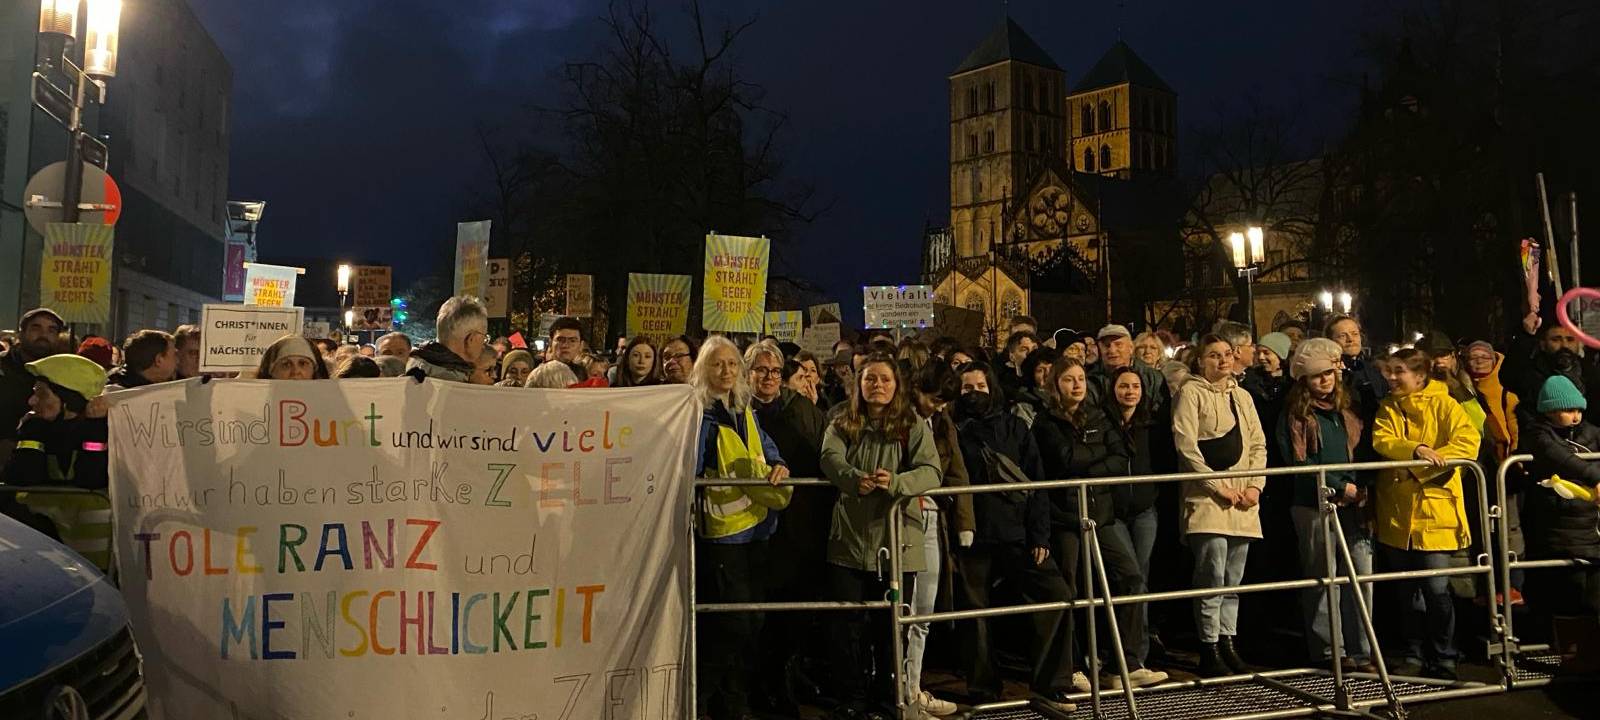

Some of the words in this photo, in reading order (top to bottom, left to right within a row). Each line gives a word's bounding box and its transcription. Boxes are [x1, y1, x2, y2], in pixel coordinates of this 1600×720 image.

[52, 260, 100, 274] STRAHLT
[713, 253, 760, 270] MÜNSTER
[59, 276, 93, 289] GEGEN
[253, 278, 289, 288] MÜNSTER
[716, 271, 758, 285] STRAHLT
[254, 288, 287, 298] STRAHLT
[636, 290, 683, 305] MÜNSTER
[722, 286, 752, 299] GEGEN
[870, 290, 927, 300] Vielfalt
[637, 306, 681, 318] STRAHLT
[642, 319, 672, 331] GEGEN
[244, 334, 257, 342] für
[121, 402, 194, 449] Wir
[195, 402, 271, 448] sind
[279, 400, 383, 447] Bunt
[392, 418, 433, 449] und
[437, 428, 467, 449] wir
[470, 427, 519, 452] sind
[532, 411, 633, 453] viele
[127, 477, 168, 509] und
[174, 487, 217, 508] wir
[228, 464, 338, 506] haben
[133, 518, 441, 580] TOLERANZ
[463, 533, 538, 576] und
[220, 584, 606, 661] MENSCHLICKEIT
[553, 664, 682, 720] ZEIT
